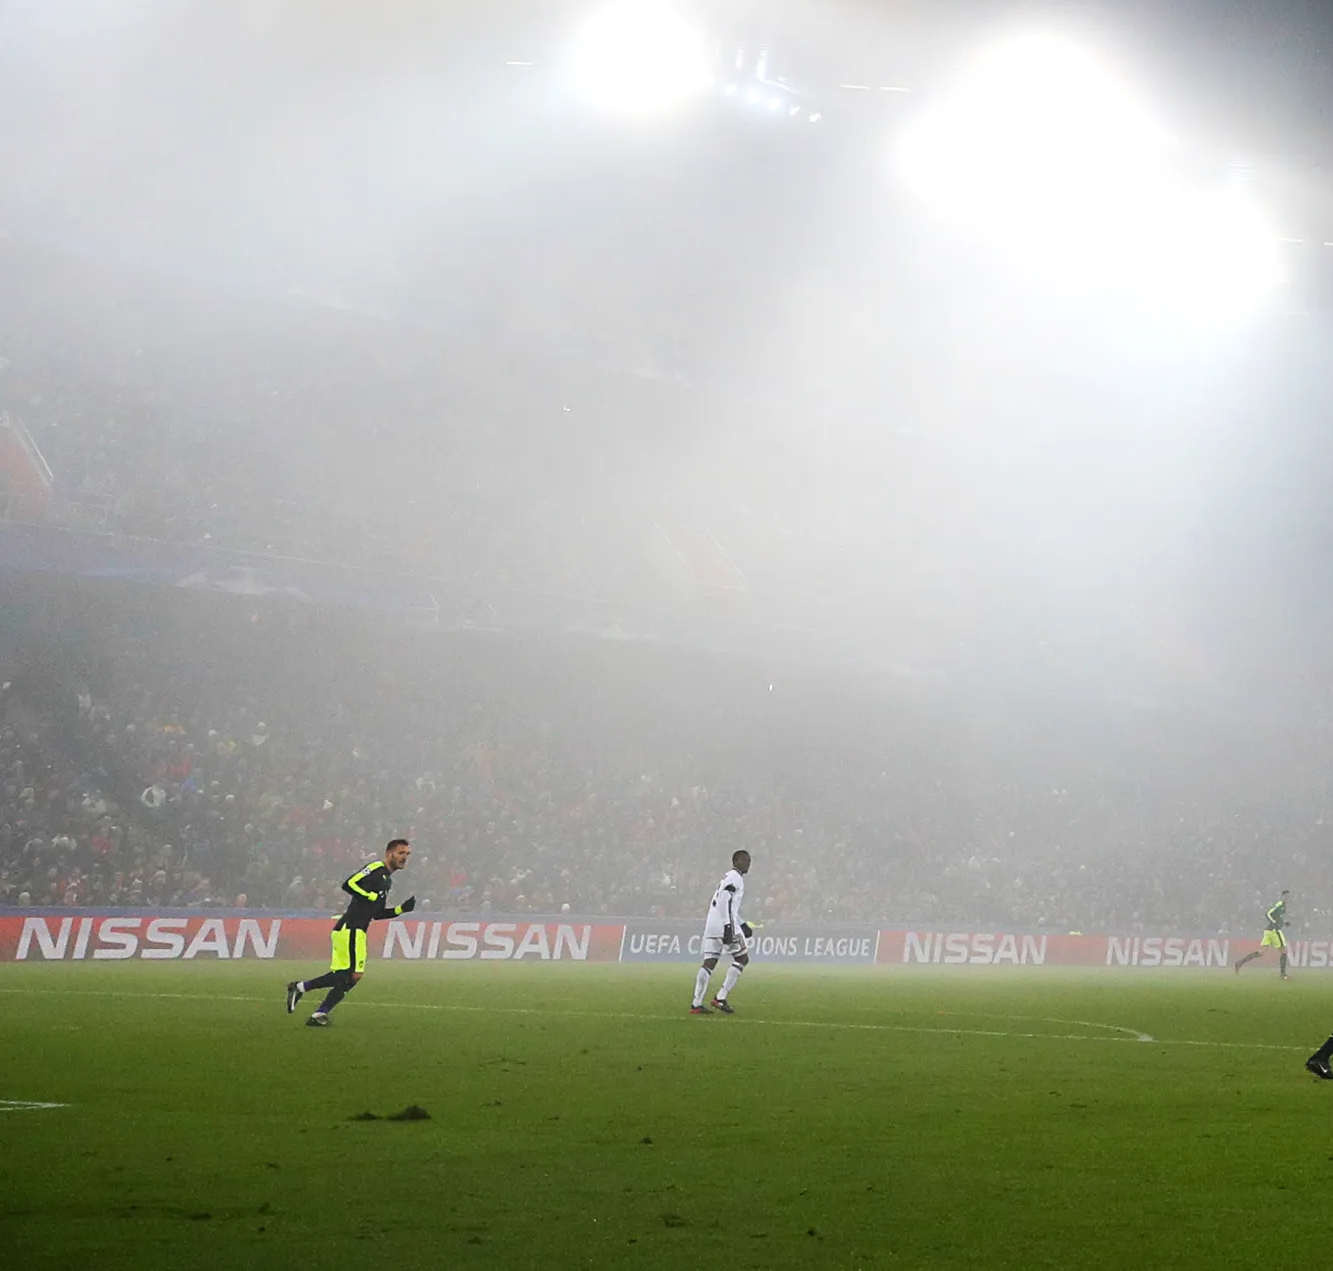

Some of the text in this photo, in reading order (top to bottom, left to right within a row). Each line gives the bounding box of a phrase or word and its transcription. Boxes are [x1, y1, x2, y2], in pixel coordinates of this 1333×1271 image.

[15, 917, 282, 960] NISSAN
[382, 920, 591, 960] NISSAN
[630, 934, 871, 957] UEFA CPIONS LEAGUE
[902, 932, 1048, 965] NISSAN
[1106, 936, 1230, 967] NISSAN
